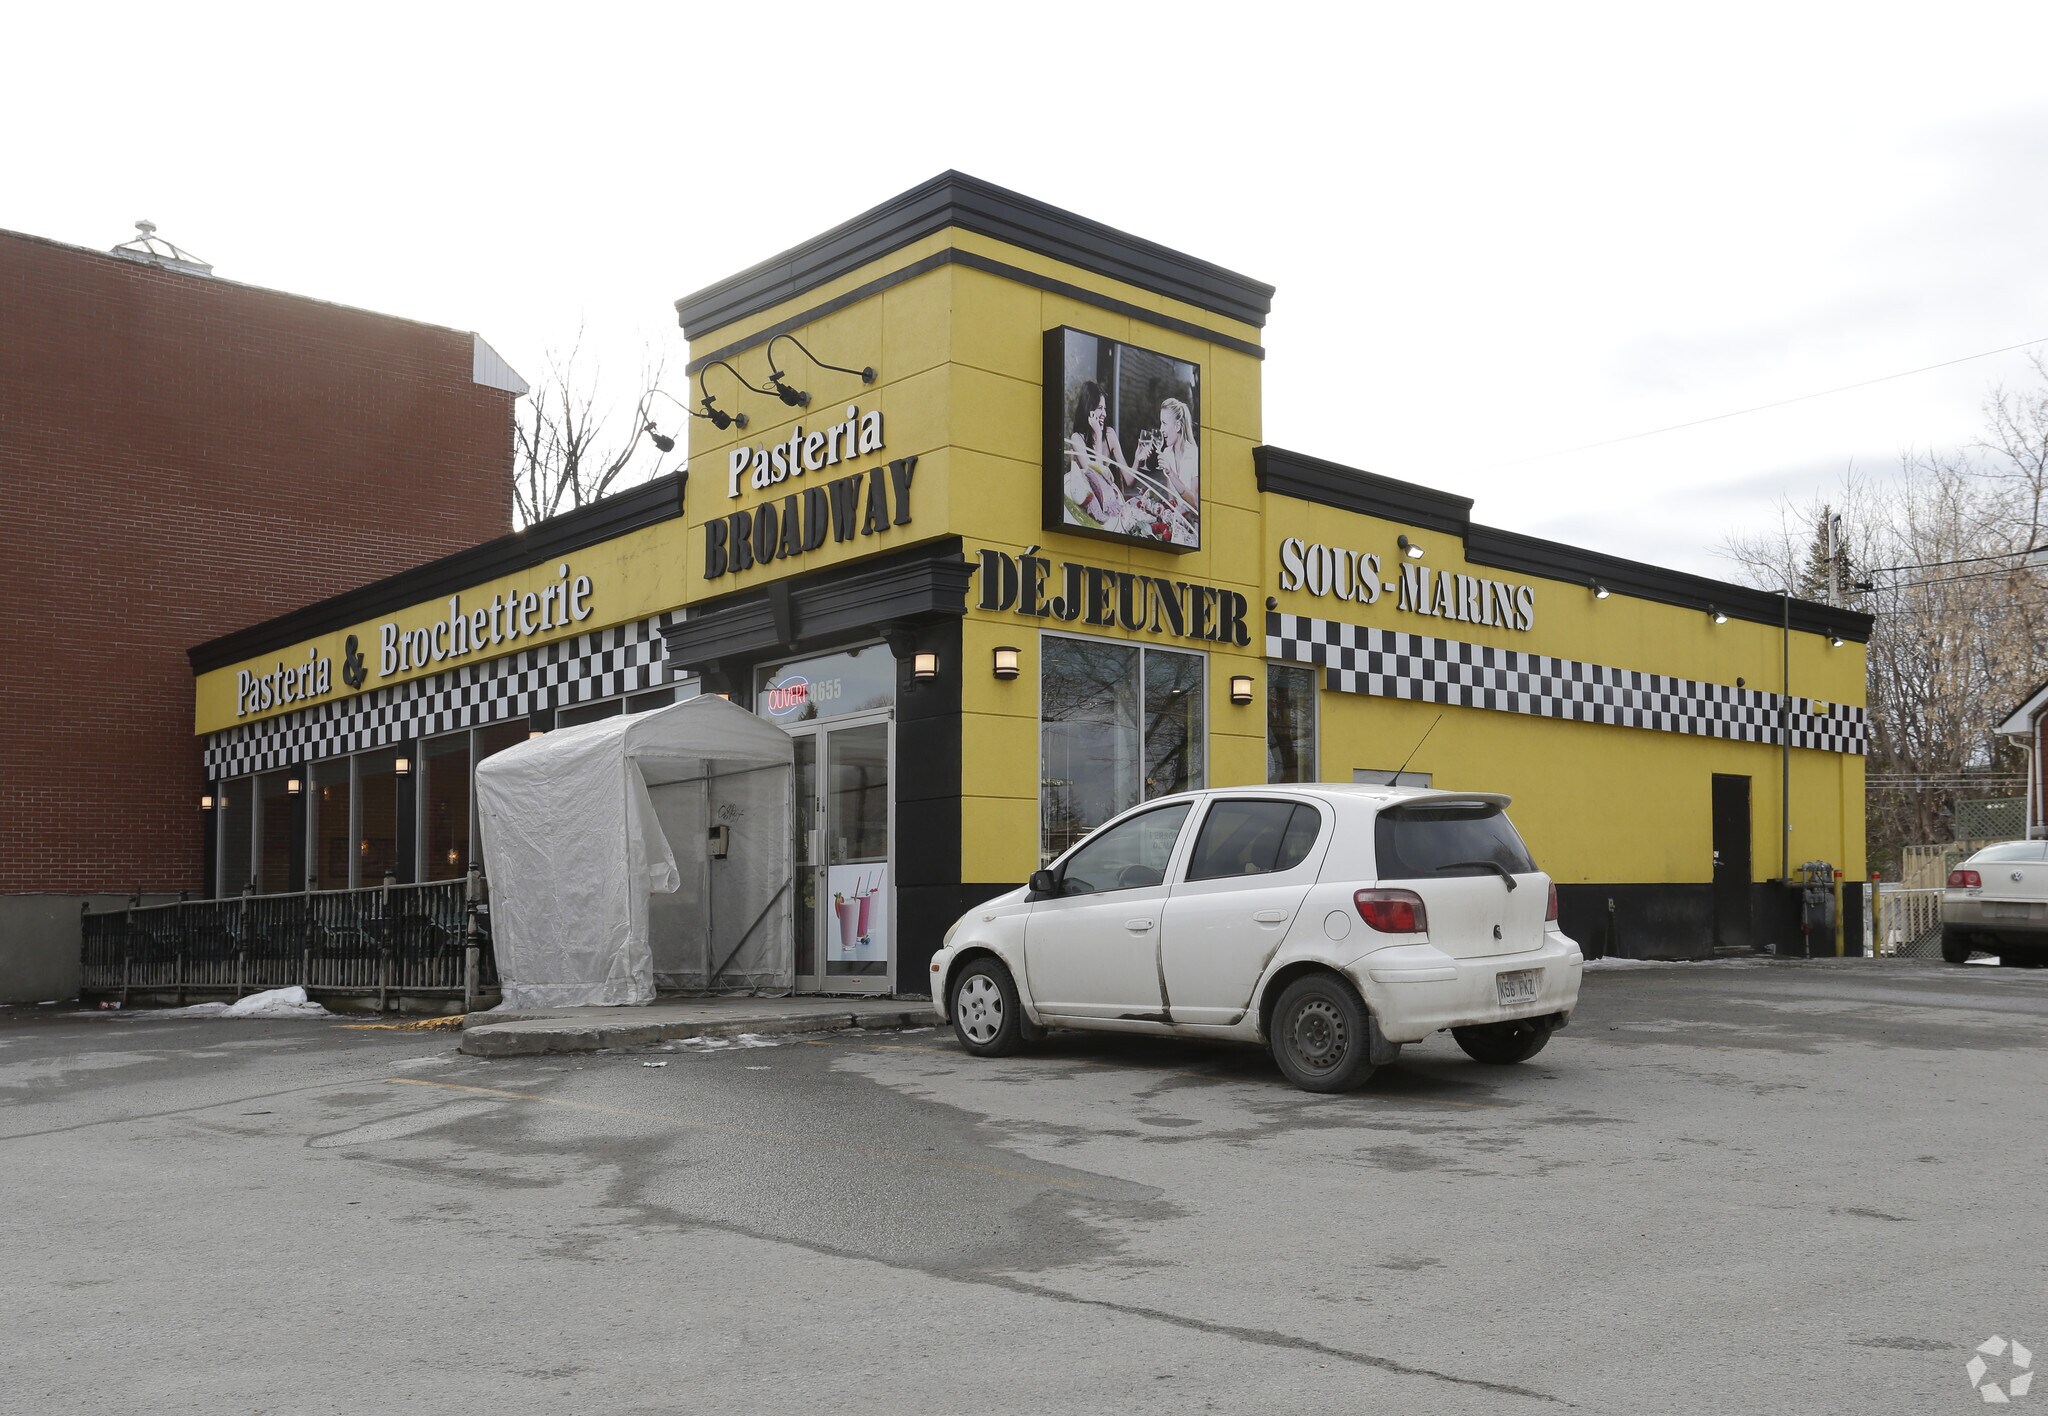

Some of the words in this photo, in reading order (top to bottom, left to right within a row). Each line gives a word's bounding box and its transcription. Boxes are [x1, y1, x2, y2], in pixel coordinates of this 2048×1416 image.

[727, 405, 886, 498] Pasteria
[704, 455, 918, 579] BROADWAY
[976, 545, 1251, 647] DÉJEUNER
[1279, 537, 1534, 631] SOUS-MARINS
[236, 647, 331, 717] Pasteria
[343, 634, 368, 690] &
[379, 563, 593, 678] Brochetterie
[768, 683, 808, 710] OUVERT
[810, 678, 842, 702] 8655
